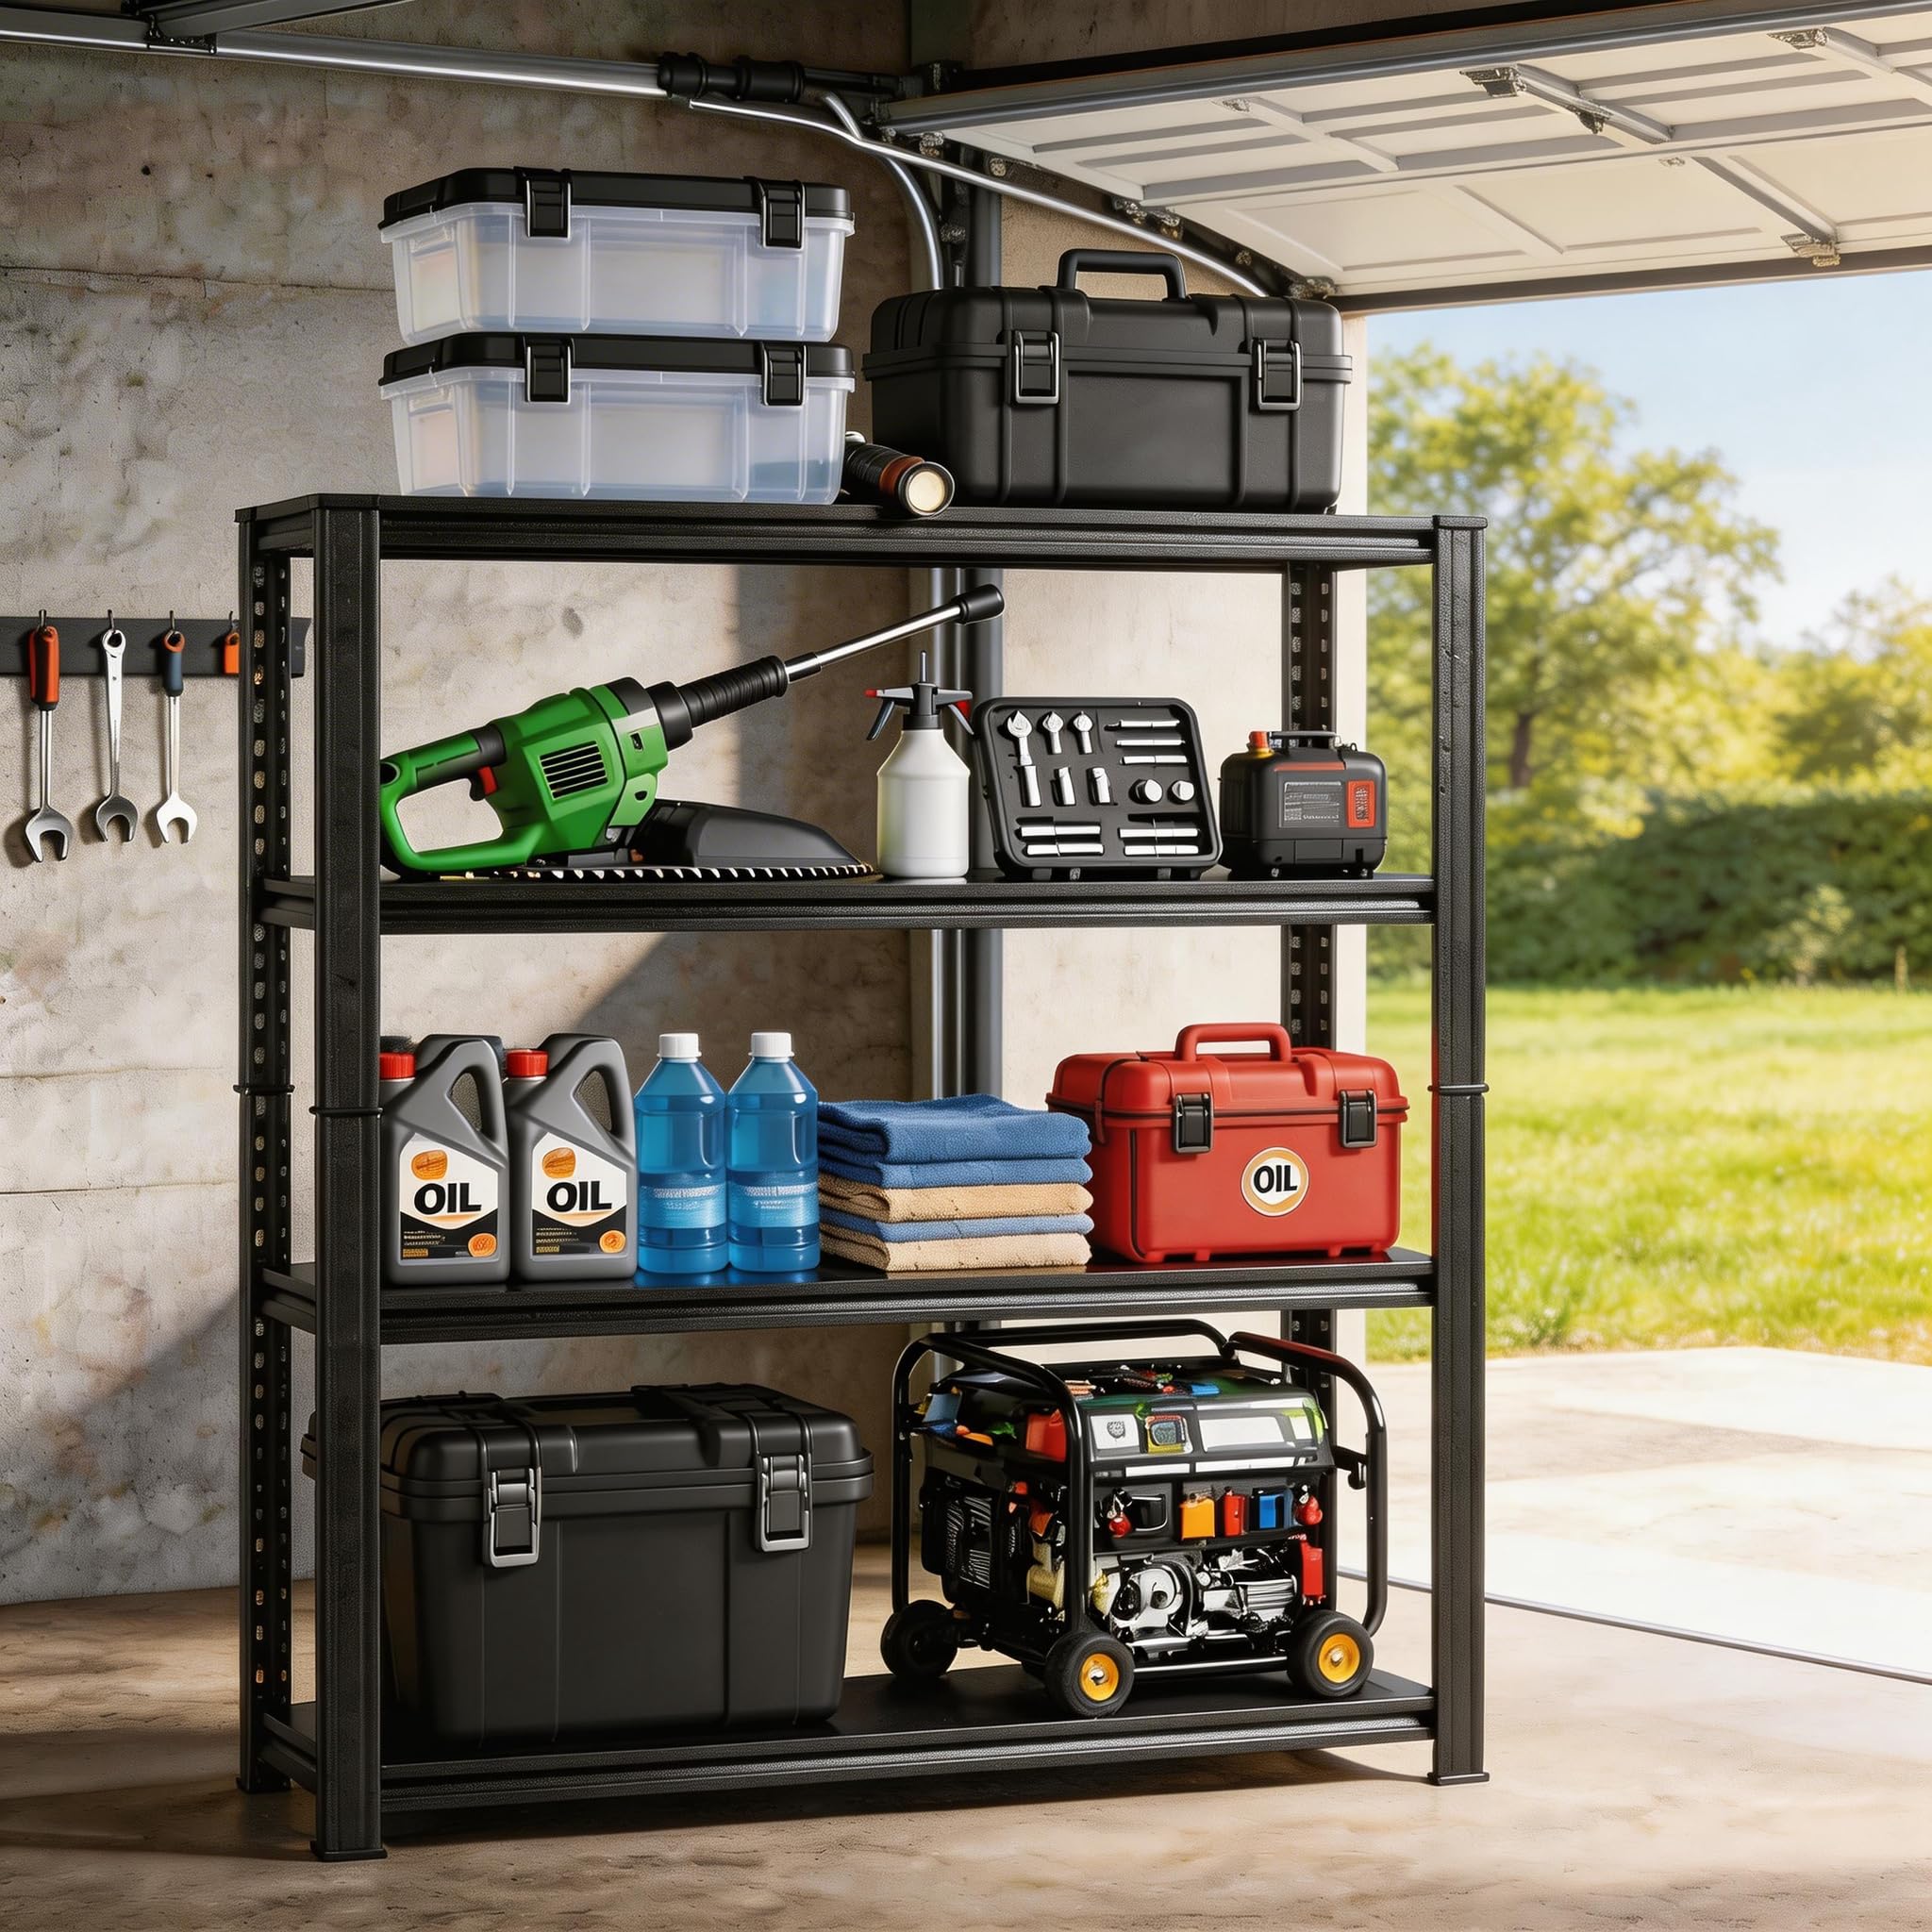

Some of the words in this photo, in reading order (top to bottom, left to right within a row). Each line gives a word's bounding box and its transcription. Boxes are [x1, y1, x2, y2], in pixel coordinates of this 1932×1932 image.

[1253, 1164, 1298, 1193] OIL
[413, 1182, 482, 1215] OIL
[546, 1180, 612, 1213] OIL
